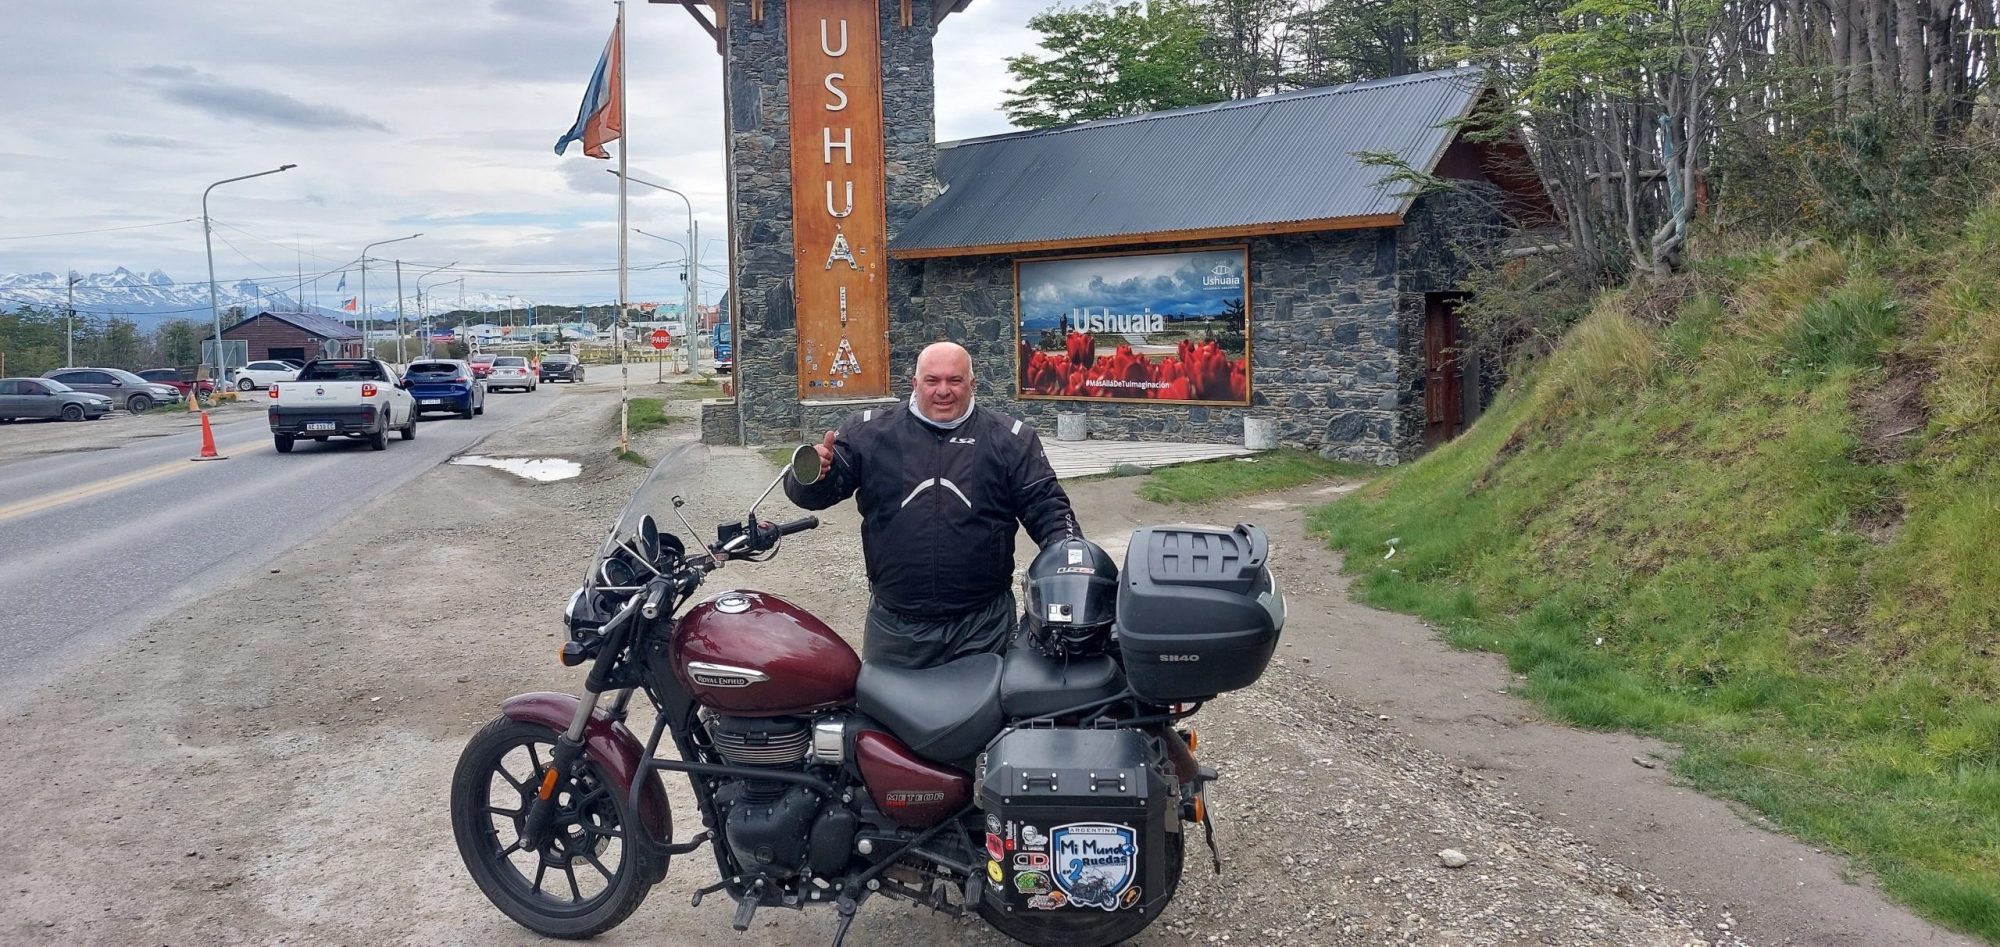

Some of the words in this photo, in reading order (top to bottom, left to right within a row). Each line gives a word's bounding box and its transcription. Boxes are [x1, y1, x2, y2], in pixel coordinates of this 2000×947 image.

[819, 18, 862, 375] USHUAIA
[1202, 275, 1240, 286] Ushuaia
[1073, 307, 1164, 333] Ushuaia
[1159, 654, 1200, 662] SH40
[697, 676, 718, 684] ROYAL
[719, 677, 745, 685] ENFIELD
[886, 792, 945, 802] METEOR
[1060, 839, 1078, 855] Mi
[1069, 858, 1084, 880] 2
[1082, 855, 1128, 866] Ruedas
